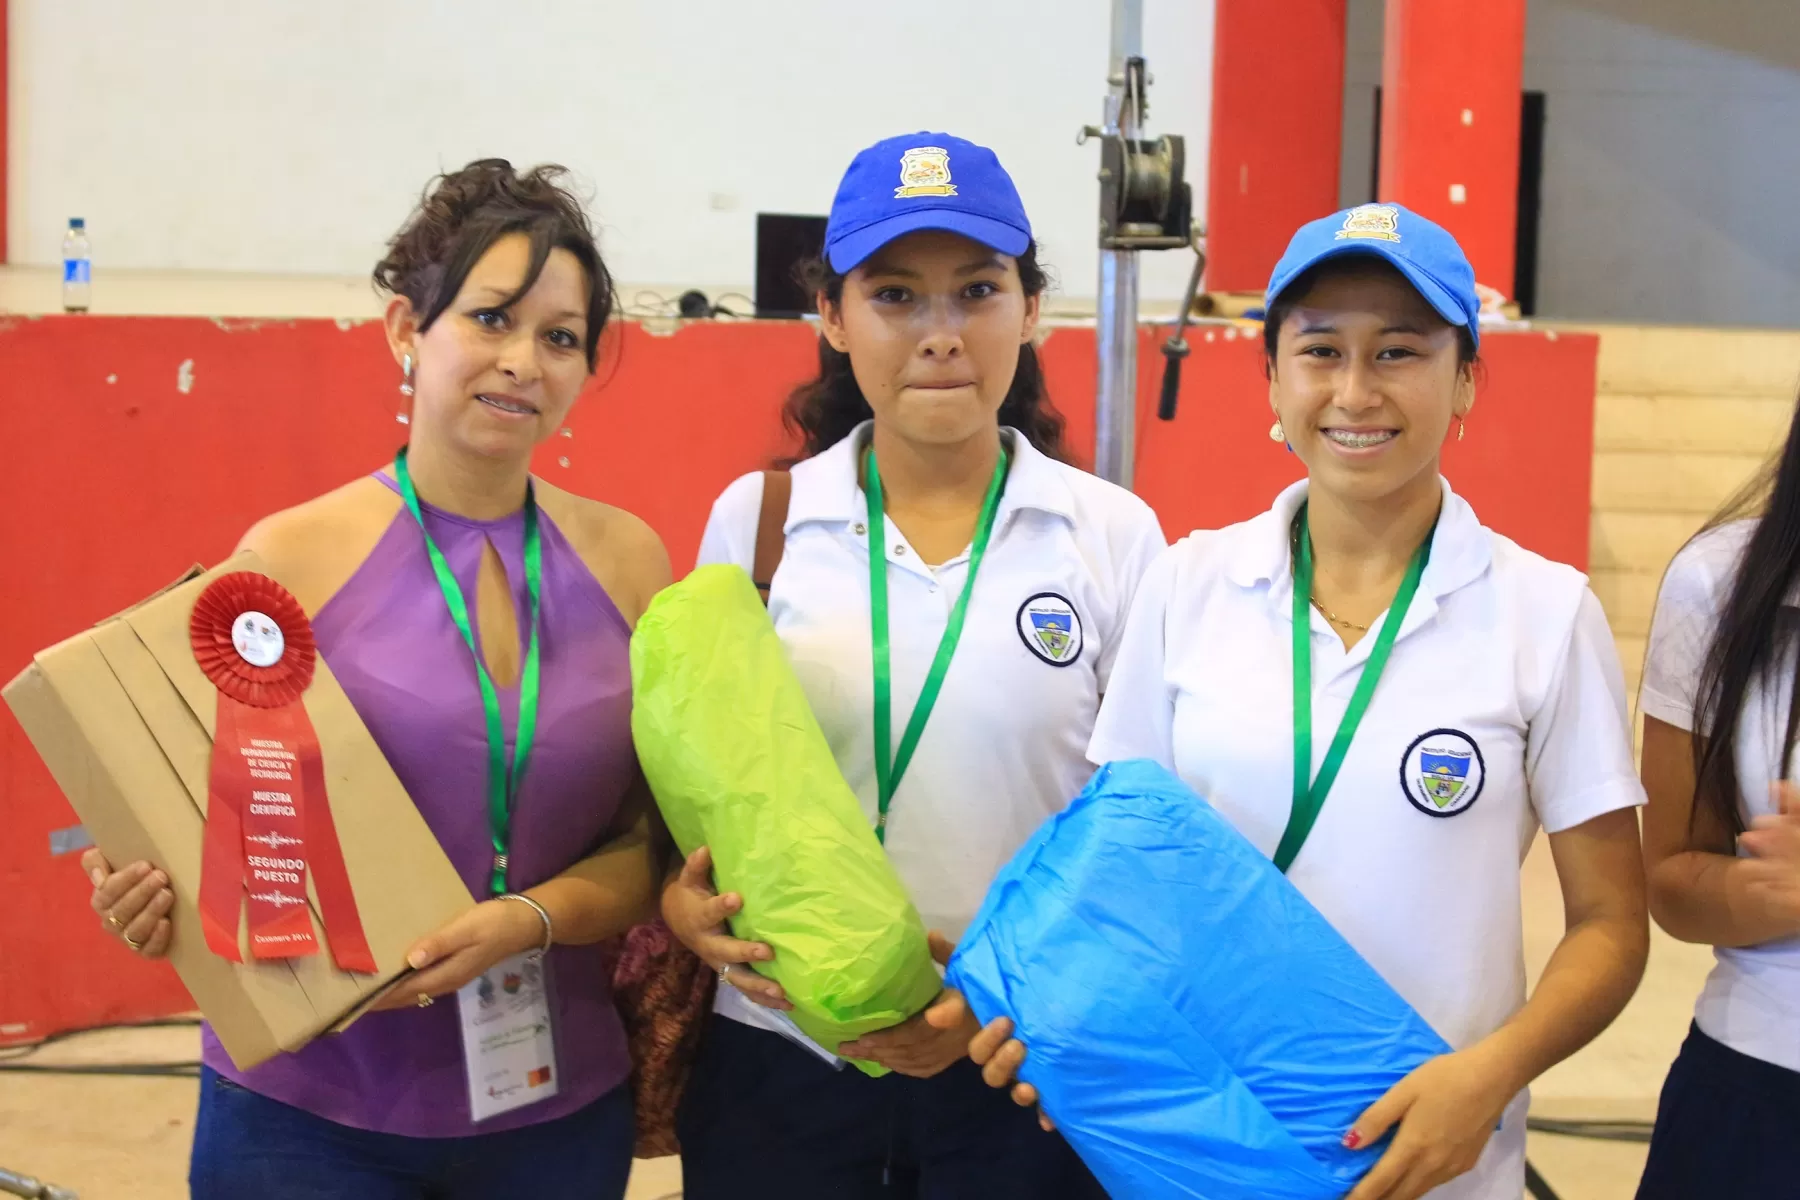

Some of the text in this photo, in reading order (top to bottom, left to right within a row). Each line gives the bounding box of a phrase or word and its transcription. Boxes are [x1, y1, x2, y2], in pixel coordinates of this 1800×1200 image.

[247, 758, 293, 771] DE CIENCIA Y
[252, 790, 292, 804] MUESTRA
[247, 855, 305, 871] SEGUNDO
[254, 869, 300, 884] PUESTO
